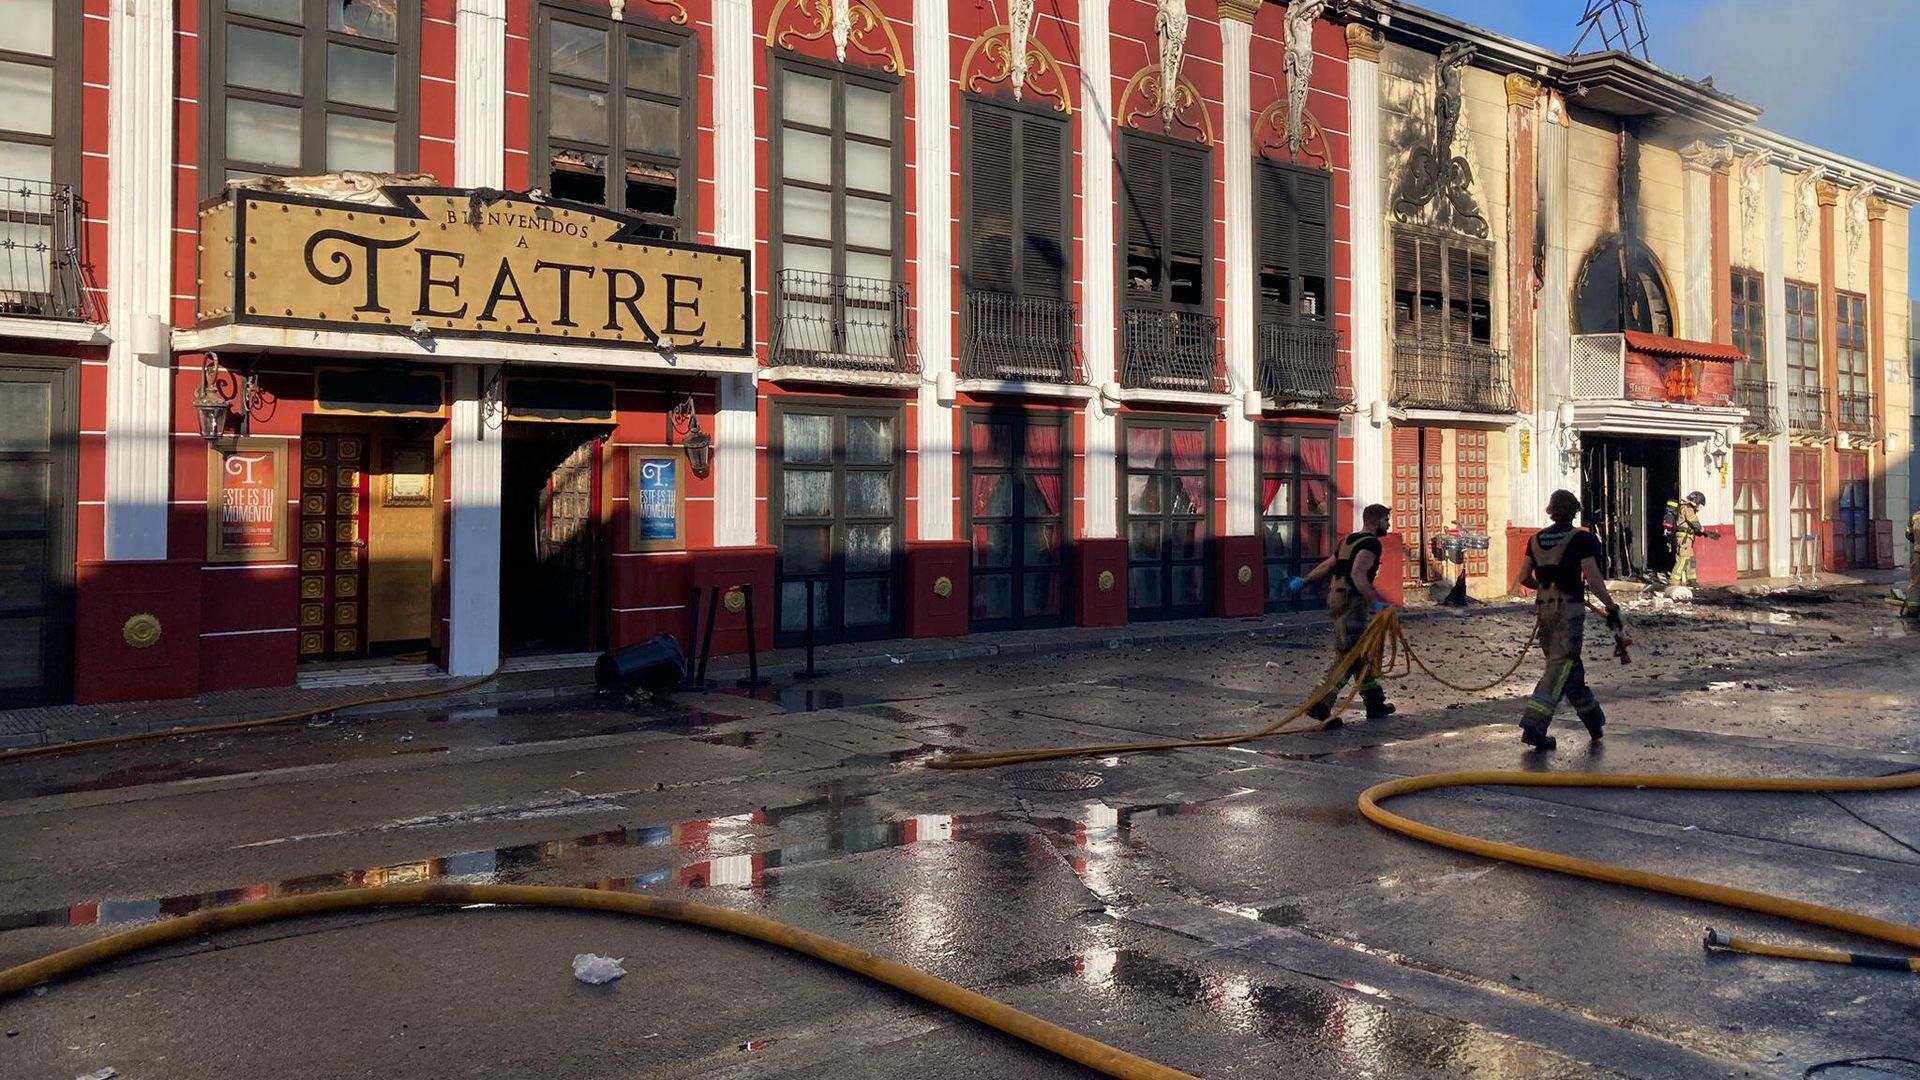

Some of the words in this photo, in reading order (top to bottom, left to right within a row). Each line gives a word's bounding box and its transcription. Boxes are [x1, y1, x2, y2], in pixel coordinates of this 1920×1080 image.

[516, 235, 529, 249] A
[304, 228, 706, 350] TEATRE
[247, 488, 259, 506] ES
[262, 488, 274, 506] TU
[223, 505, 273, 522] MOMENTO
